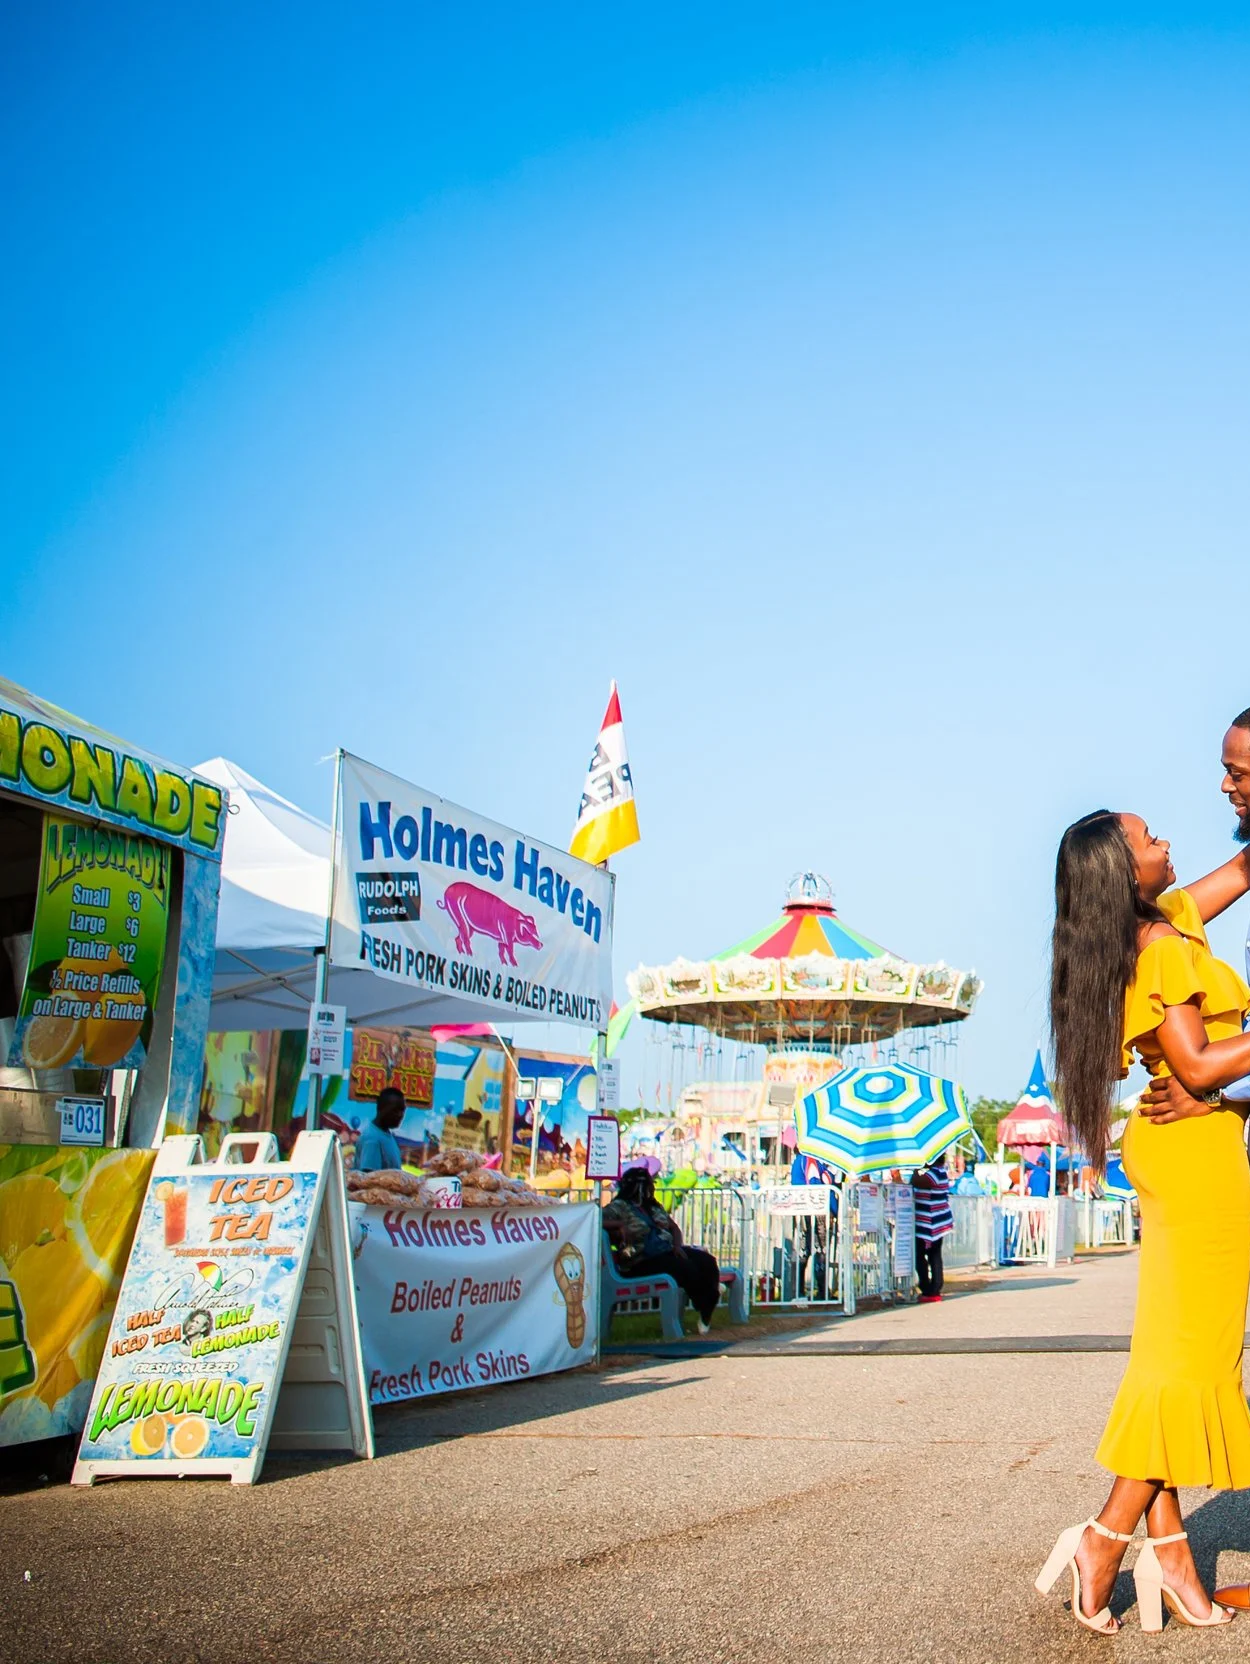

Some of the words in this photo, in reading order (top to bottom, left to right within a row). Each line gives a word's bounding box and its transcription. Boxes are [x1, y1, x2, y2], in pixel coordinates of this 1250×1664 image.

[359, 800, 505, 882] Holmes
[513, 839, 601, 944] Haven
[73, 883, 111, 908] Small
[128, 891, 142, 912] $3
[359, 878, 420, 899] RUDOLPH
[69, 911, 106, 935] Large
[126, 918, 140, 938] $6
[367, 904, 408, 917] Foods
[67, 937, 112, 961] Tanker
[118, 943, 137, 963] $12
[64, 970, 99, 992] Price
[101, 972, 140, 994] Refills
[406, 947, 447, 986] PORK
[449, 961, 492, 998] SKINS
[493, 974, 503, 1000] &
[506, 976, 547, 1012] BOILED
[549, 987, 601, 1023] PEANUTS
[33, 998, 51, 1016] on
[51, 997, 91, 1019] Large
[92, 1001, 103, 1018] &
[105, 999, 148, 1021] Tanker
[75, 1105, 102, 1134] 031
[209, 1176, 294, 1205] ICED
[209, 1211, 274, 1242] TEA
[383, 1210, 486, 1248] Holmes
[490, 1210, 560, 1245] Haven
[390, 1277, 456, 1314] Boiled
[458, 1274, 522, 1307] Peanuts
[126, 1308, 166, 1332] HALF
[215, 1304, 255, 1330] HALF
[451, 1312, 465, 1344] &
[111, 1333, 149, 1358] ICED
[151, 1323, 183, 1348] TEA
[191, 1320, 281, 1359] LEMONADE
[132, 1361, 172, 1375] FRESH
[172, 1361, 239, 1374] SQUEEZED
[368, 1364, 425, 1402] Fresh
[428, 1356, 475, 1390] Pork
[475, 1349, 531, 1382] Skins
[88, 1377, 265, 1443] LEMONADE
